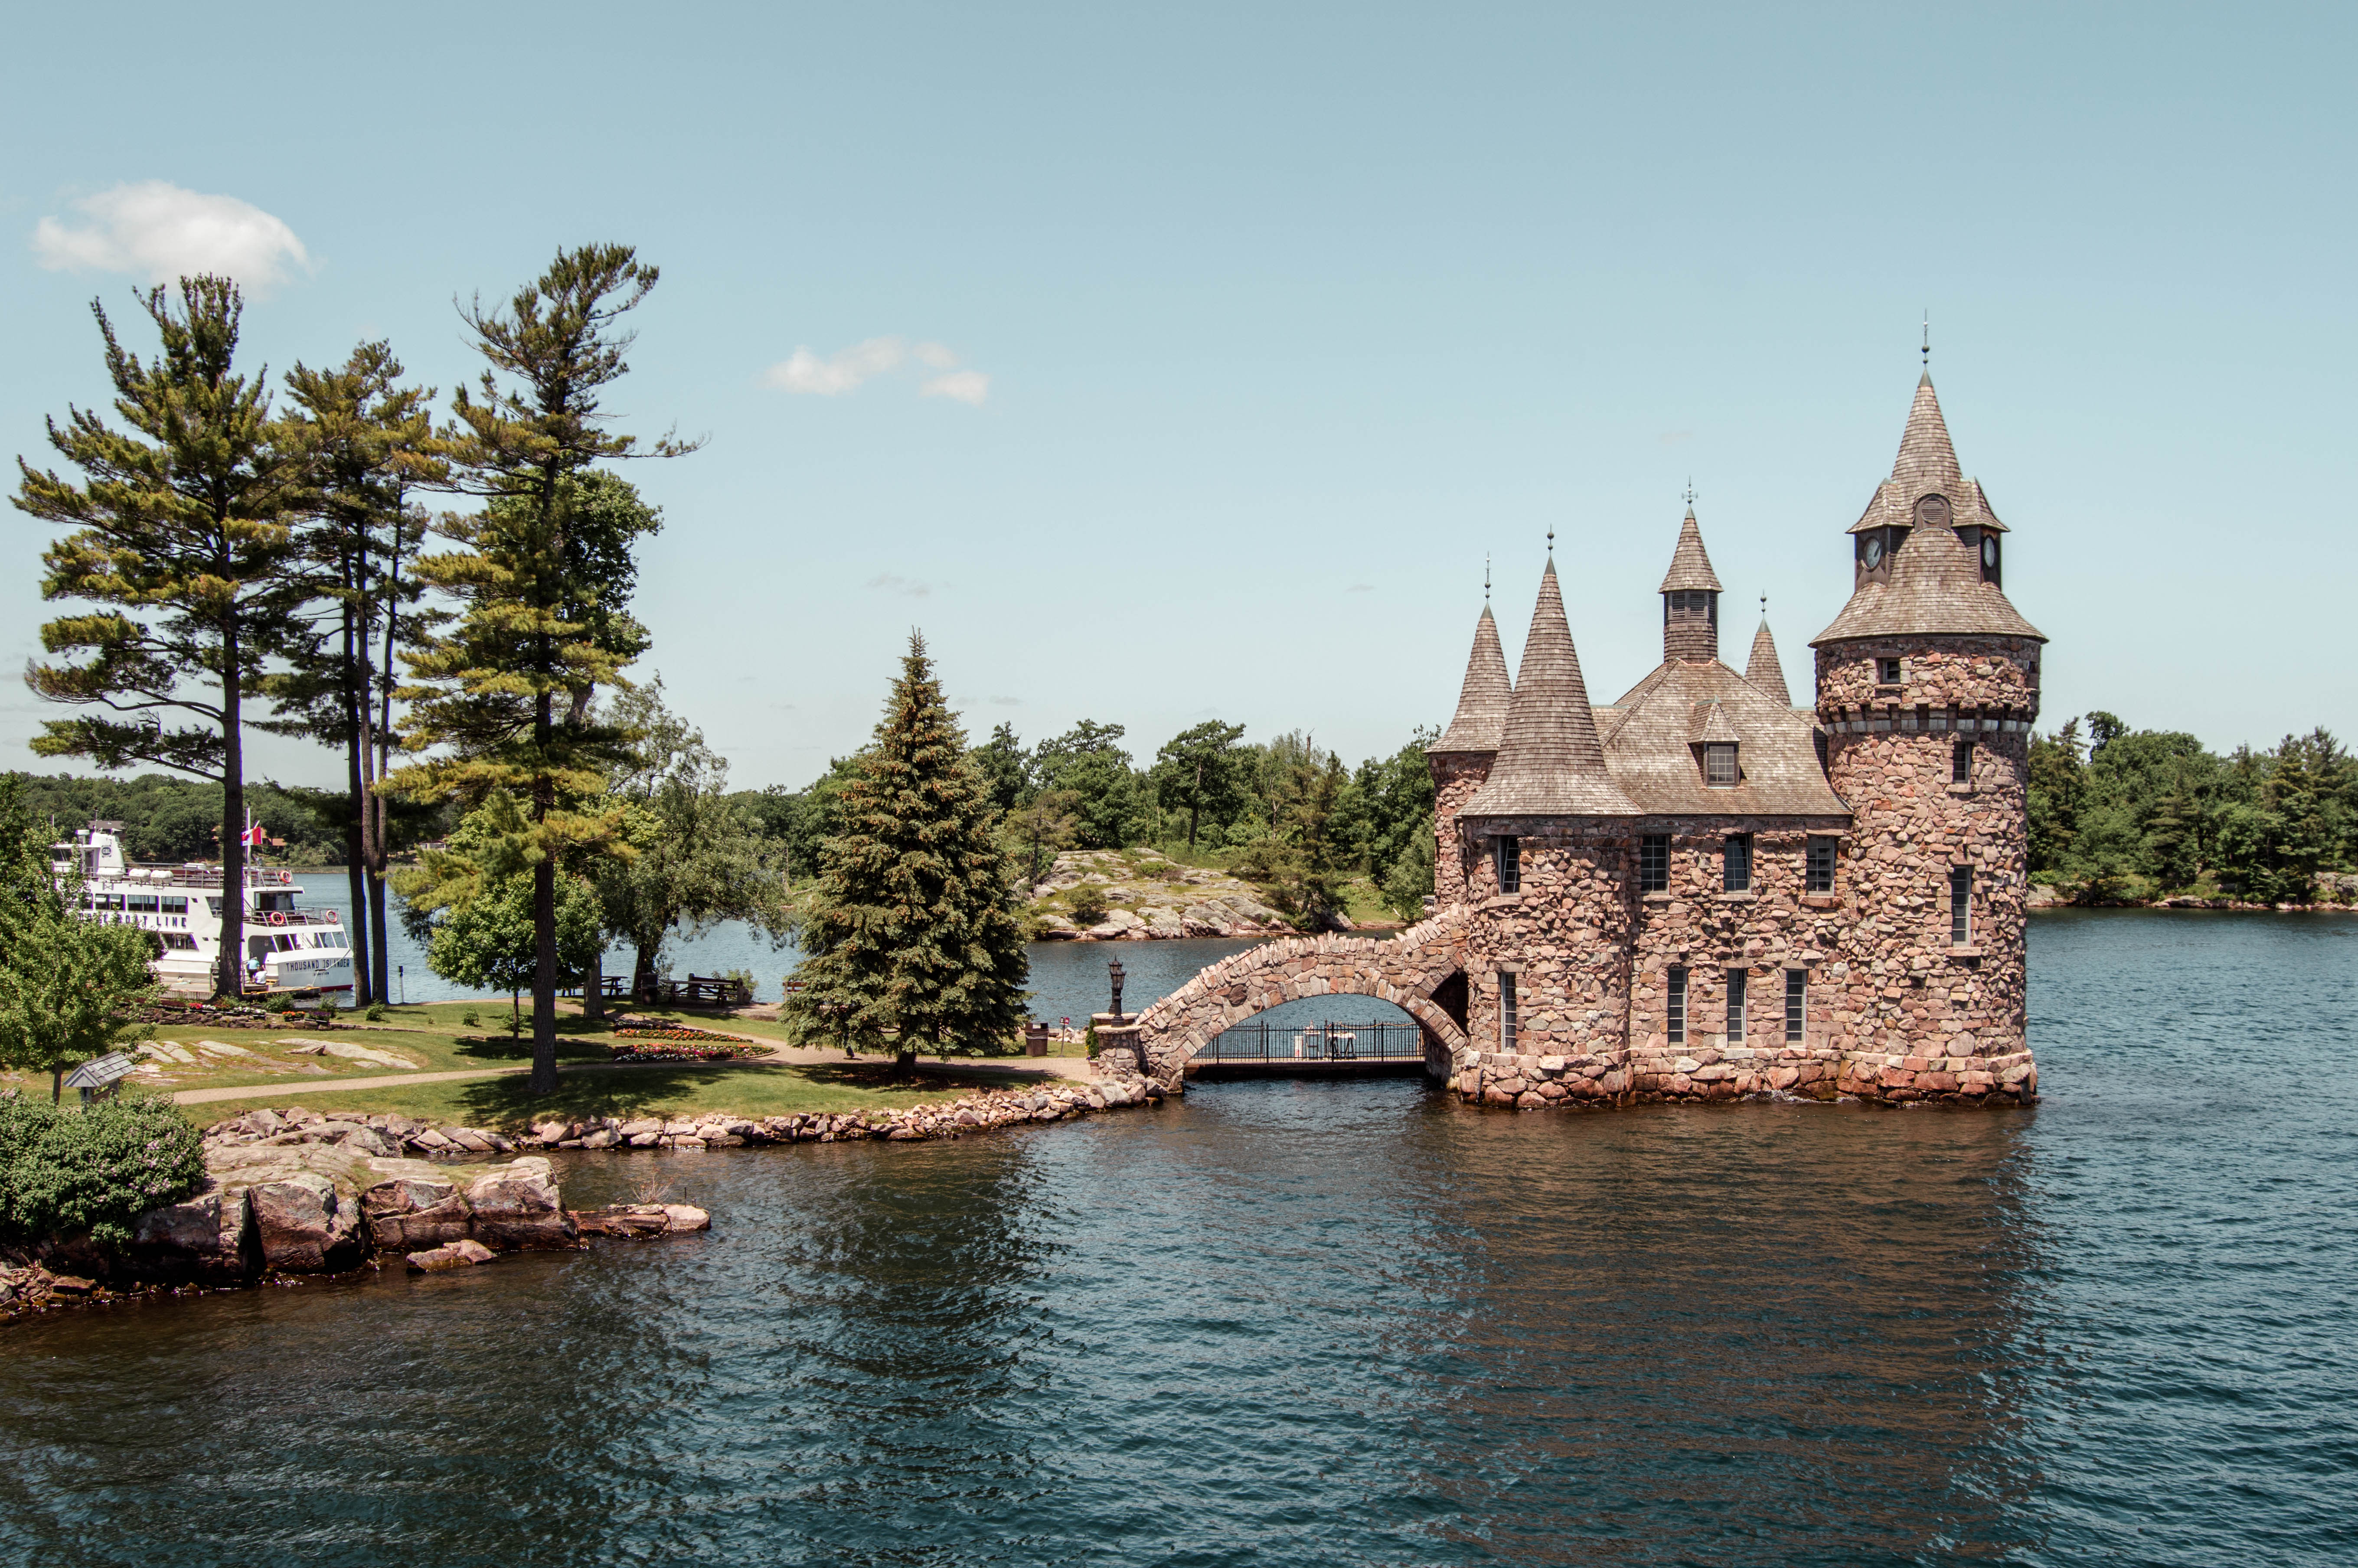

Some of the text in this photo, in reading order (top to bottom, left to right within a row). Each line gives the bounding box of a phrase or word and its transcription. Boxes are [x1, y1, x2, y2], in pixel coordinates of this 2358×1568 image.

[157, 916, 186, 927] LINE
[286, 959, 349, 971] THOUSAND ISLANDER
